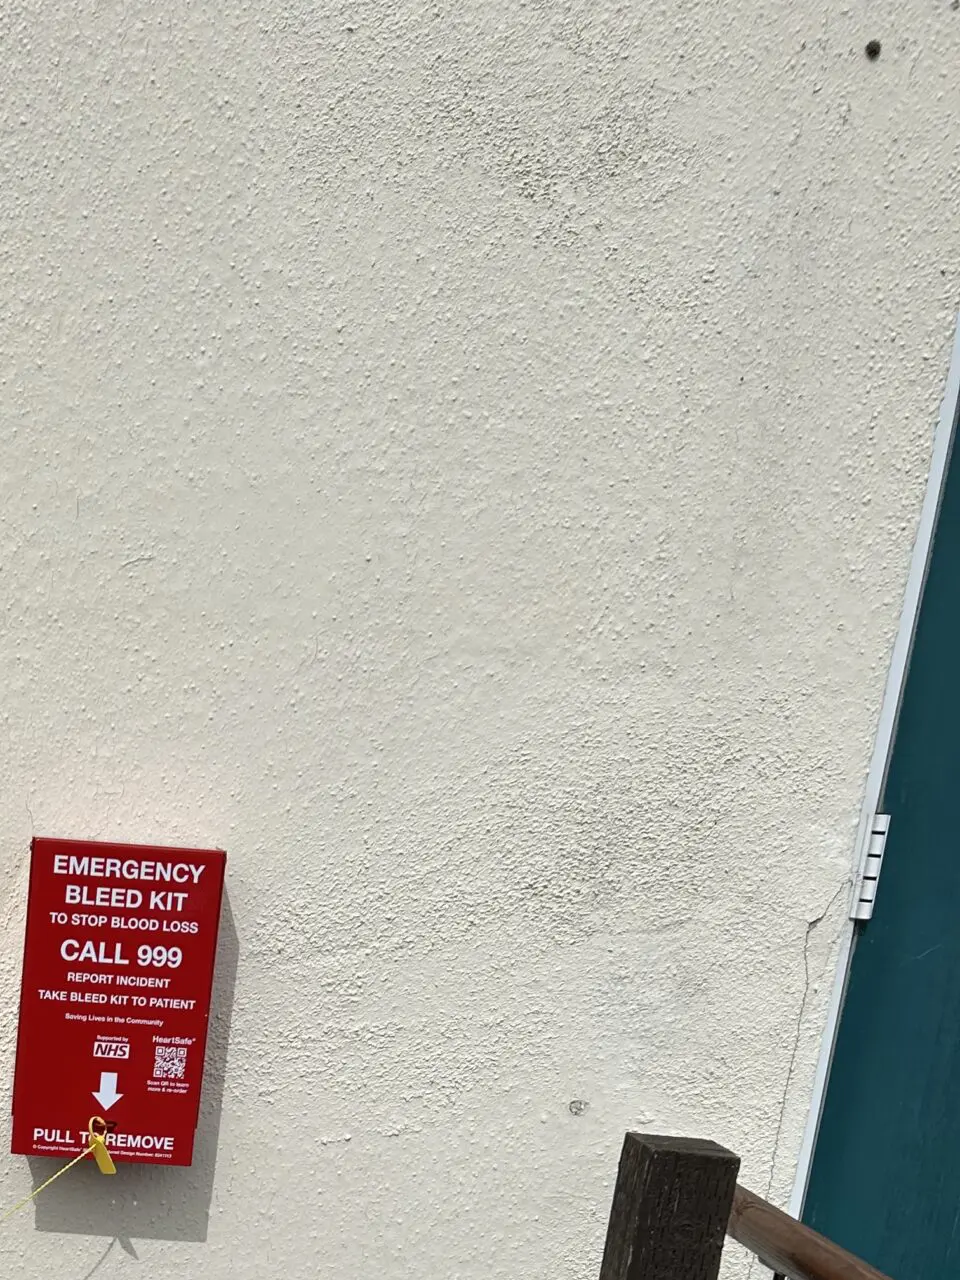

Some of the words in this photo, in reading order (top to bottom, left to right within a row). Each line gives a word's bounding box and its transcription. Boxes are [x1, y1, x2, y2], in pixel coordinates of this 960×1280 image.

[53, 854, 206, 884] EMERGENCY
[65, 884, 143, 909] BLEED
[149, 890, 189, 912] KIT
[49, 911, 68, 925] TO
[71, 913, 108, 927] STOP
[111, 917, 159, 931] BLOOD
[162, 920, 199, 934] LOSS
[60, 938, 130, 965] CALL
[137, 944, 183, 969] 999
[67, 972, 114, 985] REPORT
[116, 975, 171, 989] INCIDENT
[38, 989, 68, 1001] TAKE
[70, 992, 108, 1004] BLEED
[110, 994, 129, 1005] KIT
[131, 996, 146, 1007] TO
[149, 997, 197, 1010] PATIENT
[65, 1012, 87, 1021] Saving
[88, 1014, 105, 1022] Lives
[126, 1017, 164, 1027] Community
[95, 1043, 128, 1057] NHS
[33, 1128, 75, 1144] PULL
[105, 1133, 175, 1150] REMOVE
